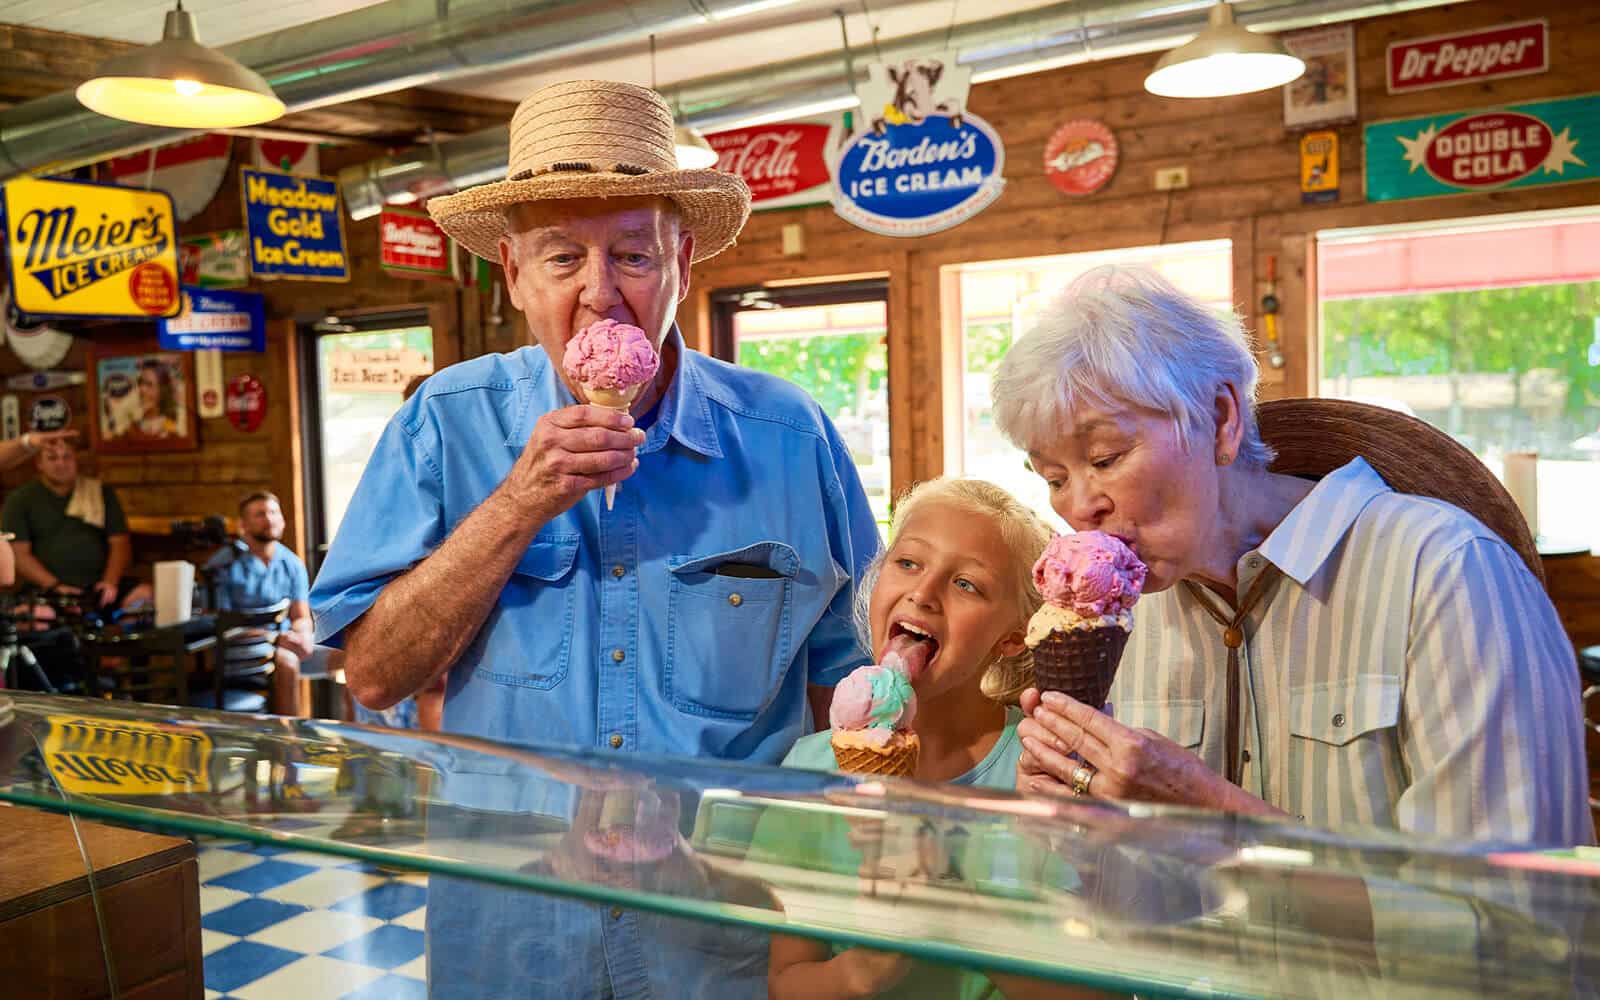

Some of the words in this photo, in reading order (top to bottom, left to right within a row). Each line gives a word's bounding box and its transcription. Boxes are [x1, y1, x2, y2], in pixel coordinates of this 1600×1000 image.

[858, 130, 977, 173] Borden's
[1435, 124, 1543, 159] DOUBLE
[851, 176, 889, 198] ICE
[895, 165, 983, 193] CREAM
[1453, 150, 1527, 180] COLA
[247, 175, 337, 212] Meadow
[17, 205, 165, 269] Meier's
[268, 208, 325, 240] Gold
[52, 263, 91, 298] ICE
[94, 245, 159, 278] CREAM
